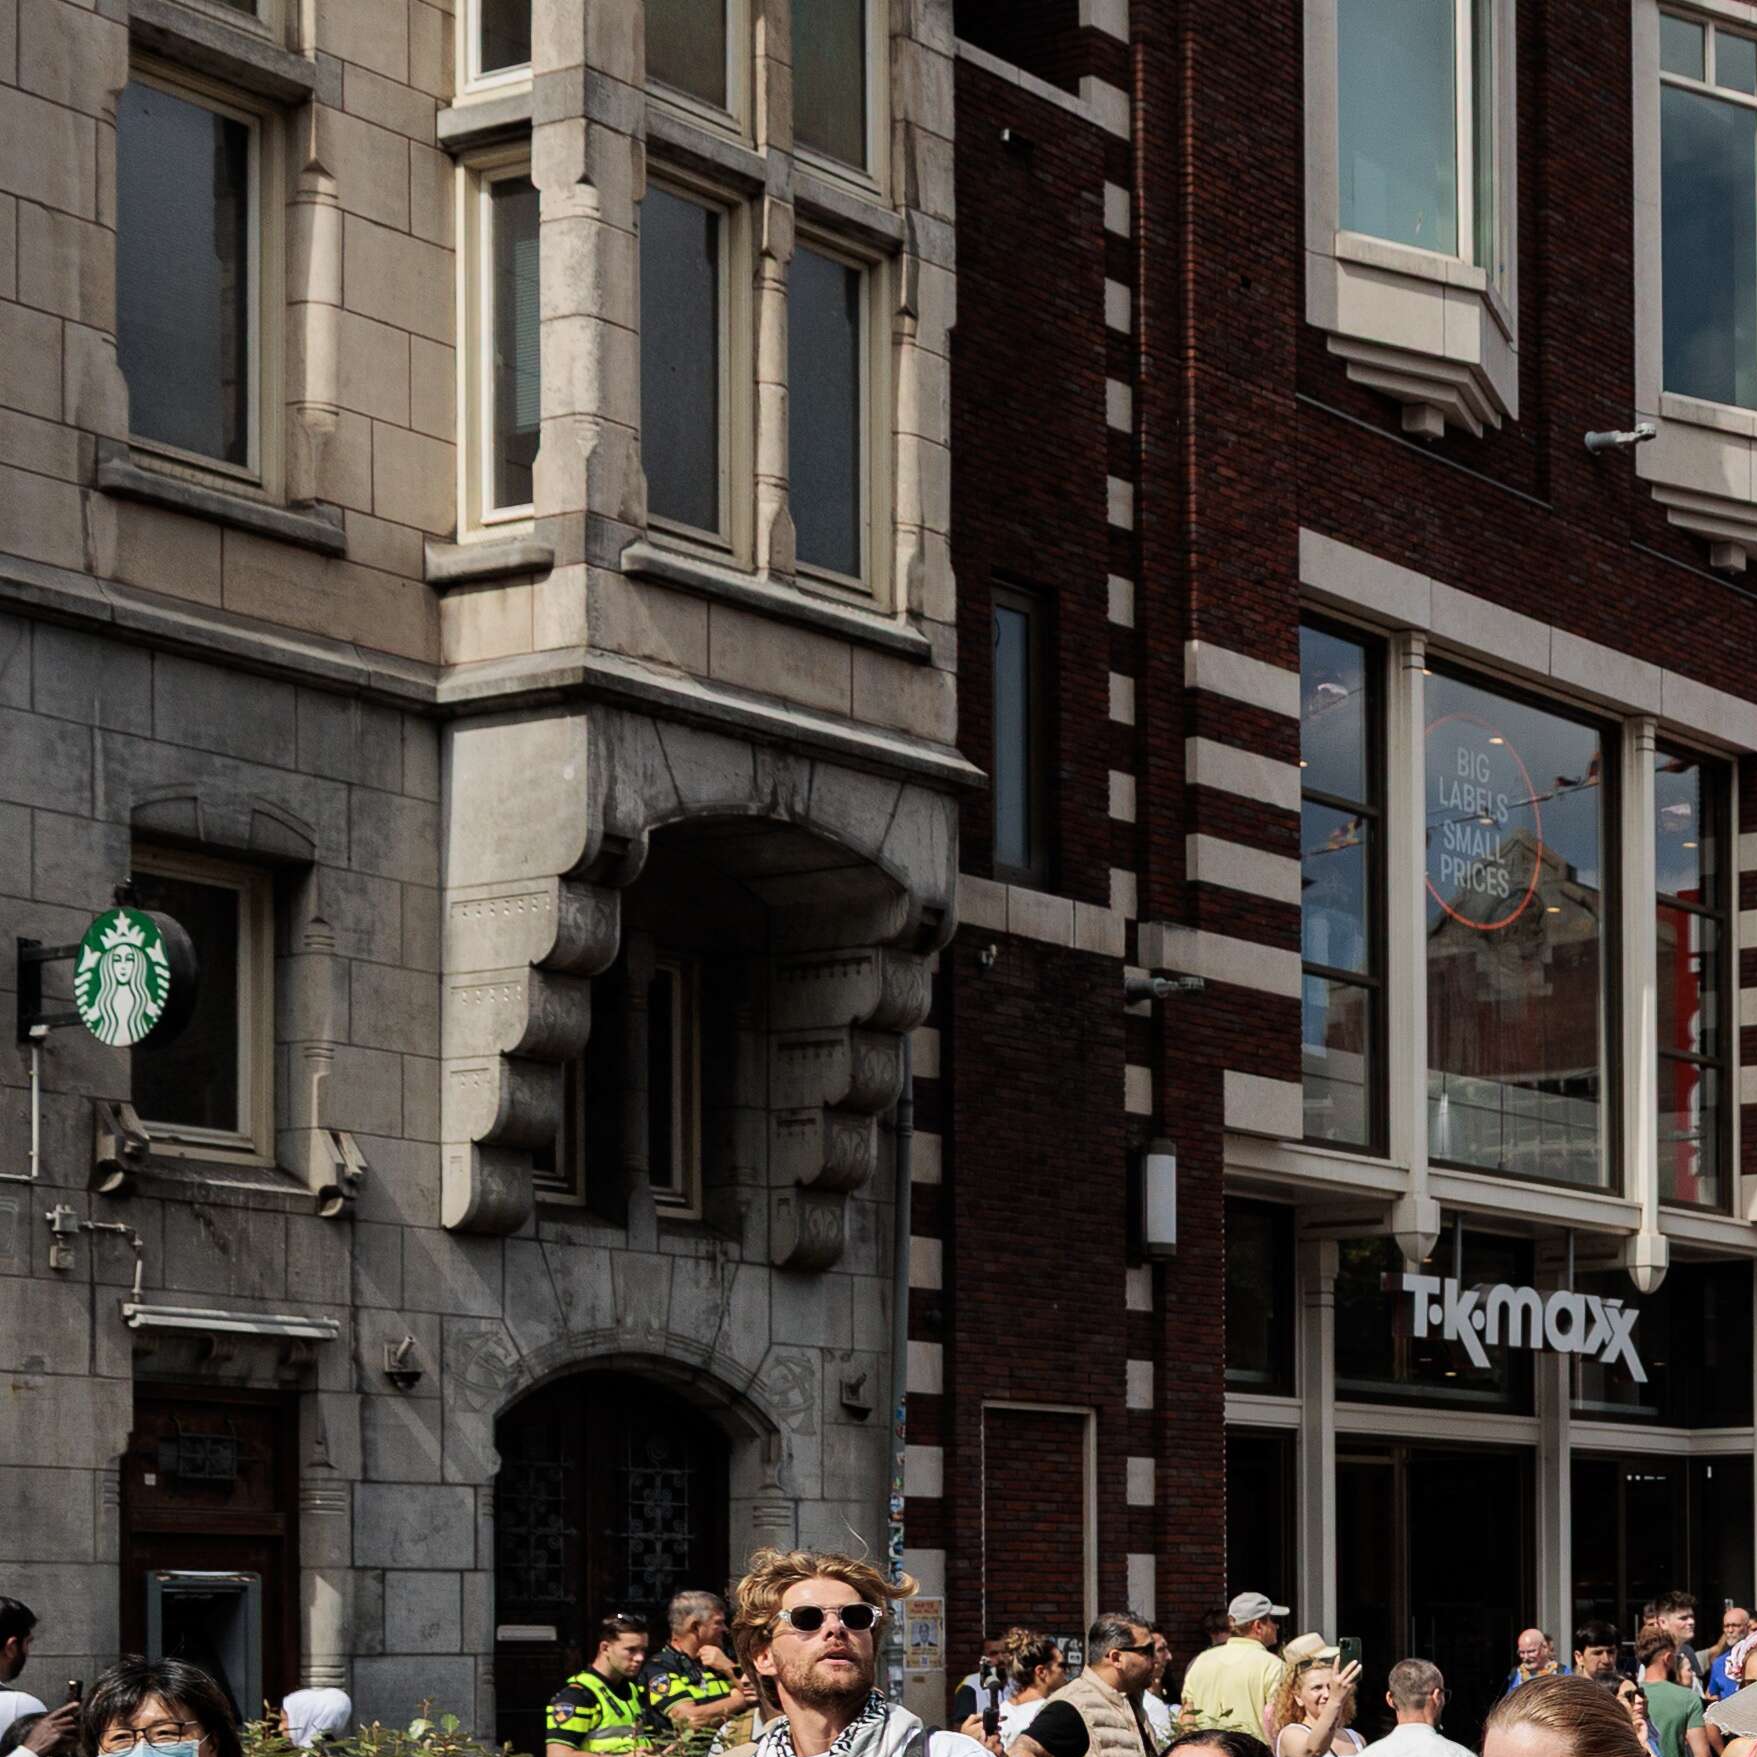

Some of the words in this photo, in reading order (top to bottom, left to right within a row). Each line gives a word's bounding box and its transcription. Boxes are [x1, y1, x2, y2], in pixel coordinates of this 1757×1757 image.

[1457, 748, 1490, 783] BIG
[1439, 776, 1509, 823] LABELS
[1443, 820, 1505, 863] SMALL
[1440, 854, 1510, 898] PRICES
